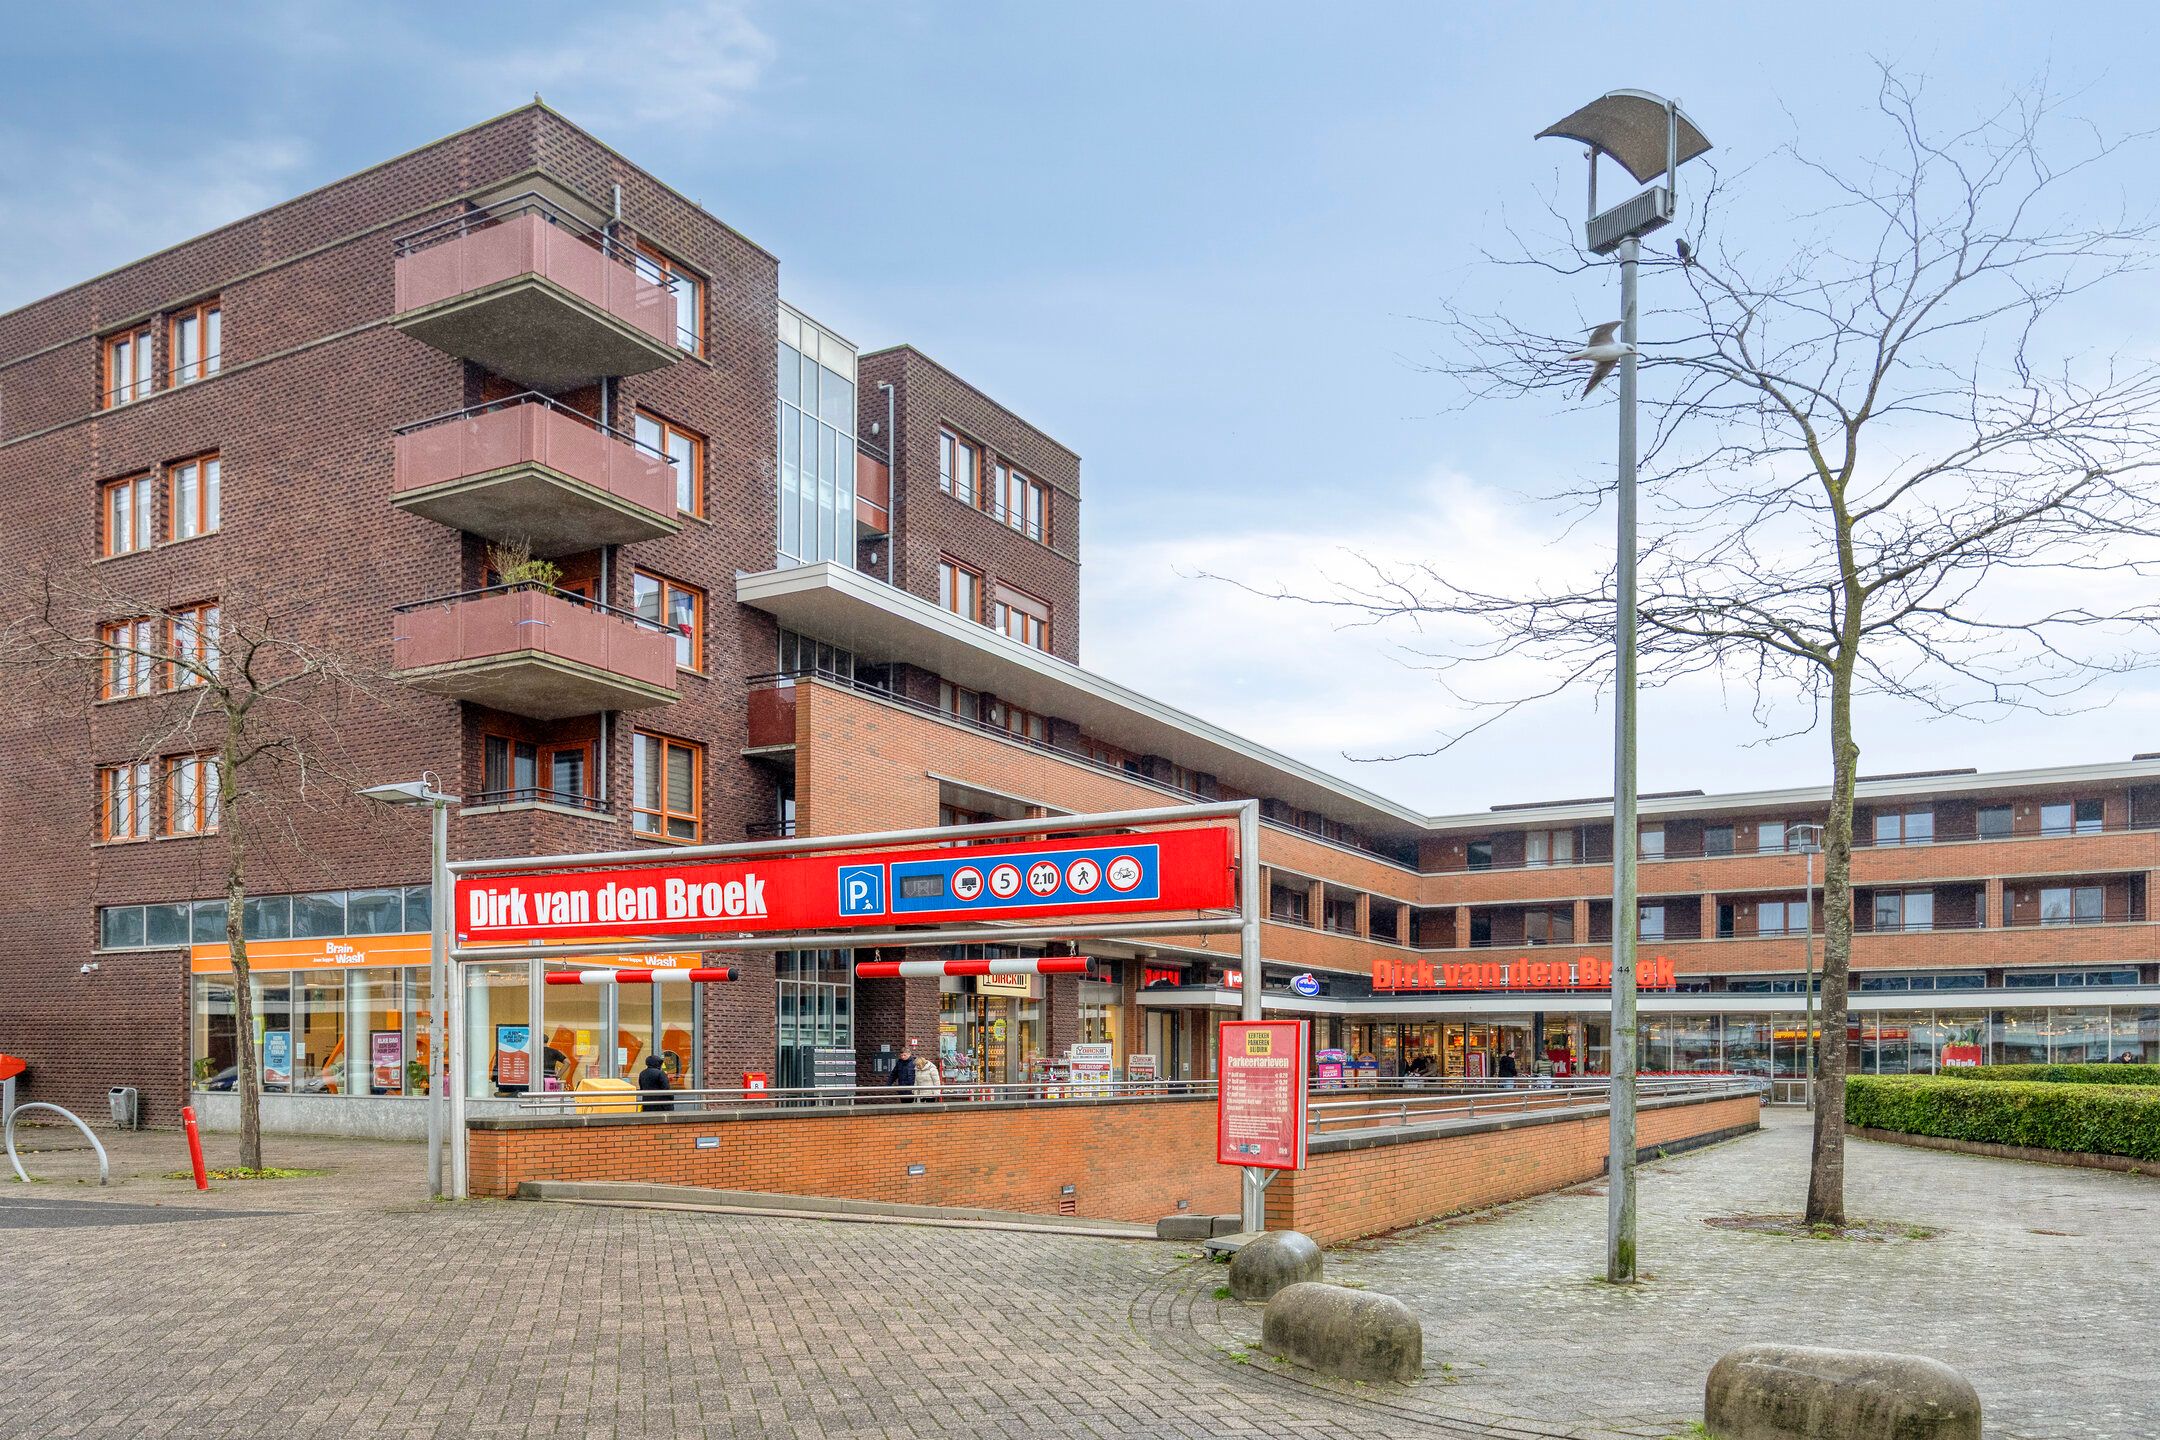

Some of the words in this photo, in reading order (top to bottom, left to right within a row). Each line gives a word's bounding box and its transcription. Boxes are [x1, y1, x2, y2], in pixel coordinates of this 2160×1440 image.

[1000, 873, 1010, 889] 5
[1033, 872, 1055, 885] 2.10
[469, 887, 528, 926] Dirk
[534, 890, 590, 924] van
[596, 882, 658, 922] den
[665, 873, 768, 919] Broek
[849, 880, 868, 910] P
[326, 942, 353, 954] Brain
[335, 952, 365, 964] Wash
[644, 955, 677, 967] Wash
[1372, 959, 1437, 987] Dirk
[1443, 962, 1502, 987] van
[1509, 957, 1571, 987] den
[1578, 956, 1677, 986] Brek
[1616, 965, 1631, 974] 44
[1227, 1056, 1289, 1069] Parkeertarieven
